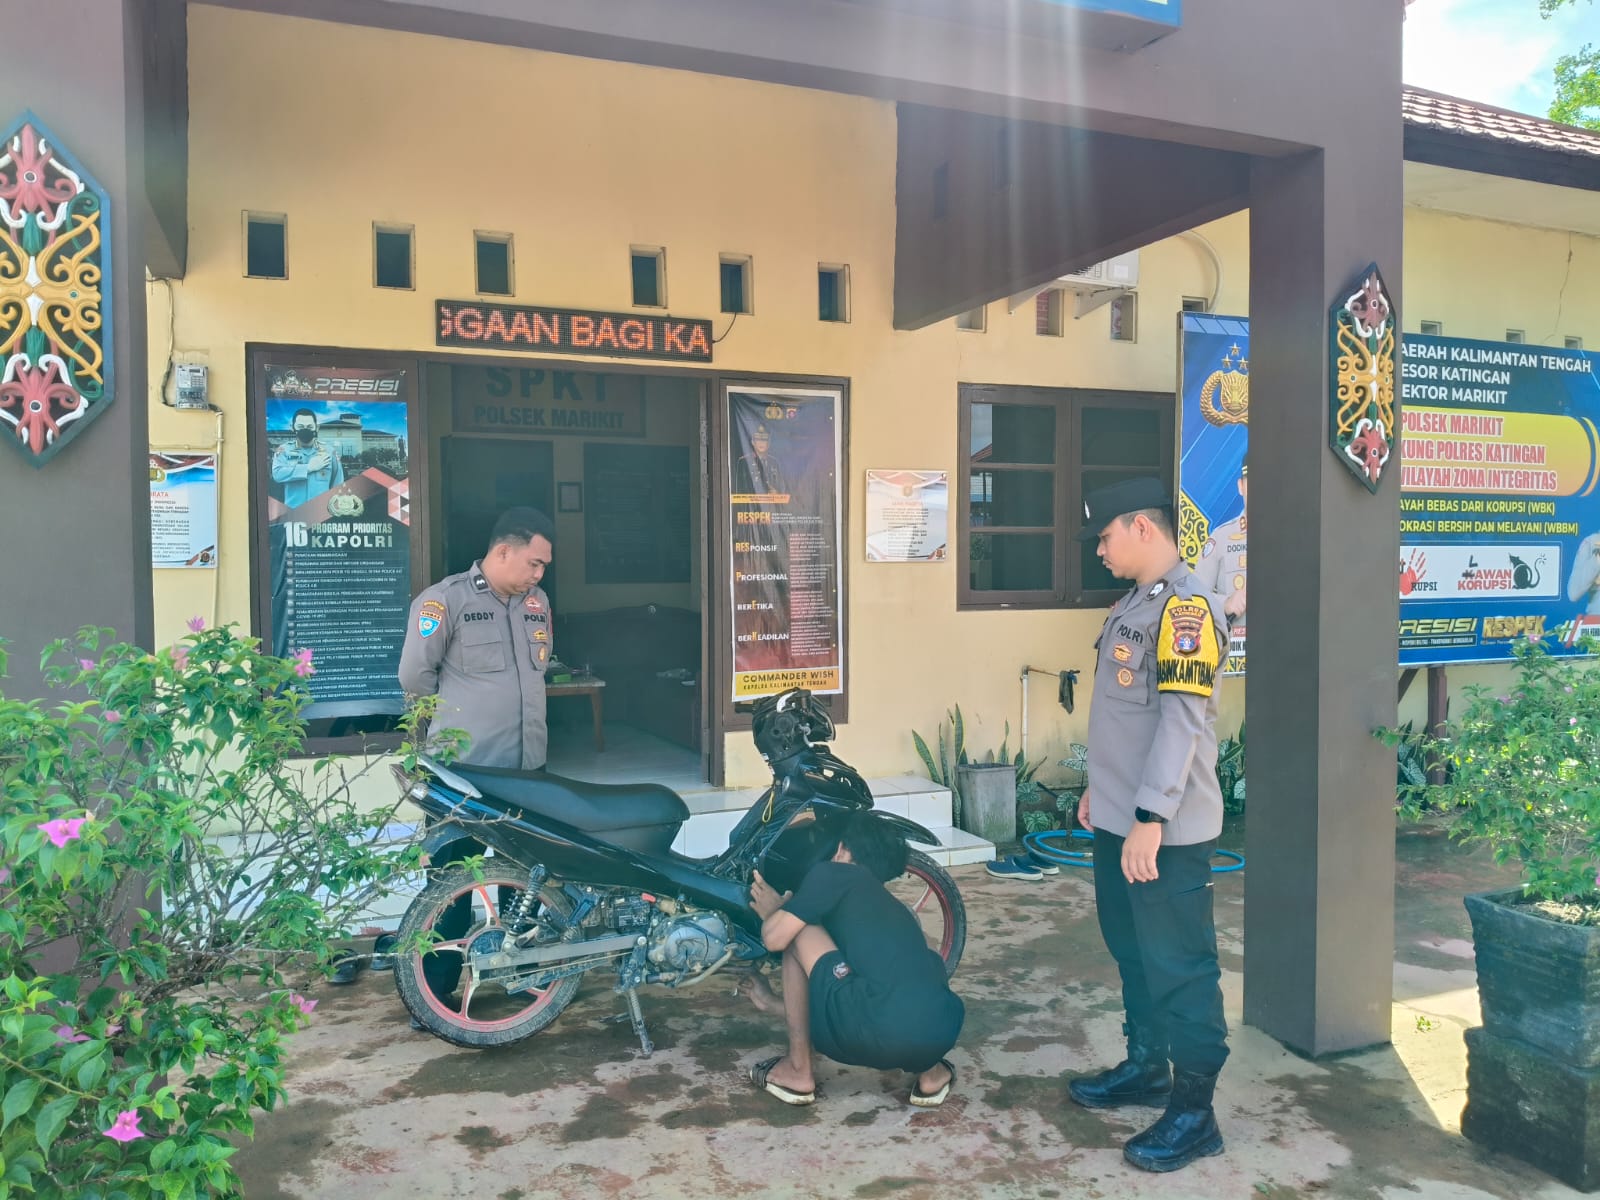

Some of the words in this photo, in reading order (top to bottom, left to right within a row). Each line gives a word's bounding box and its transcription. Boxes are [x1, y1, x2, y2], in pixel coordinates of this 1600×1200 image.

[570, 315, 654, 350] BAGI
[663, 322, 709, 354] KA
[1401, 342, 1447, 360] AERAH
[1451, 347, 1538, 368] KALIMANTAN
[1540, 355, 1591, 373] TENGAH
[1402, 363, 1438, 379] ESOR
[1441, 366, 1510, 385] KATINGAN
[314, 377, 400, 391] PRESISI
[1402, 384, 1448, 400] EKTOR
[1451, 387, 1508, 404] MARIKIT
[474, 406, 546, 427] POLSEK
[551, 409, 625, 429] MARIKIT
[1401, 412, 1448, 433] POLSEK
[1450, 415, 1504, 436] MARIKIT
[1436, 441, 1483, 462] POLRES
[1485, 444, 1546, 464] KATINGAN
[1453, 468, 1485, 488] ZONA
[1487, 469, 1557, 490] INTEGRITAS
[1400, 499, 1425, 512] AYAH
[1426, 499, 1459, 512] BEBAS
[1461, 500, 1484, 513] DARI
[1486, 501, 1526, 513] KORUPSI
[1528, 502, 1556, 516] (WBK)
[283, 521, 309, 547] 16
[311, 523, 351, 534] PROGRAM
[352, 523, 393, 534] PRIORITAS
[1400, 520, 1435, 532] OKRASI
[1437, 520, 1472, 532] BERSIH
[1474, 521, 1495, 533] DAN
[1497, 522, 1542, 533] MELAYANI
[311, 535, 393, 548] KAPOLRI
[736, 571, 788, 582] PROFESIONAL
[1457, 579, 1512, 591] KORUPSI
[1411, 581, 1438, 592] RUPSI
[464, 612, 495, 622] DEDDY
[1117, 624, 1144, 644] POLRI
[1400, 618, 1477, 634] RESISI
[743, 672, 807, 683] COMMANDER
[810, 670, 834, 679] WISH
